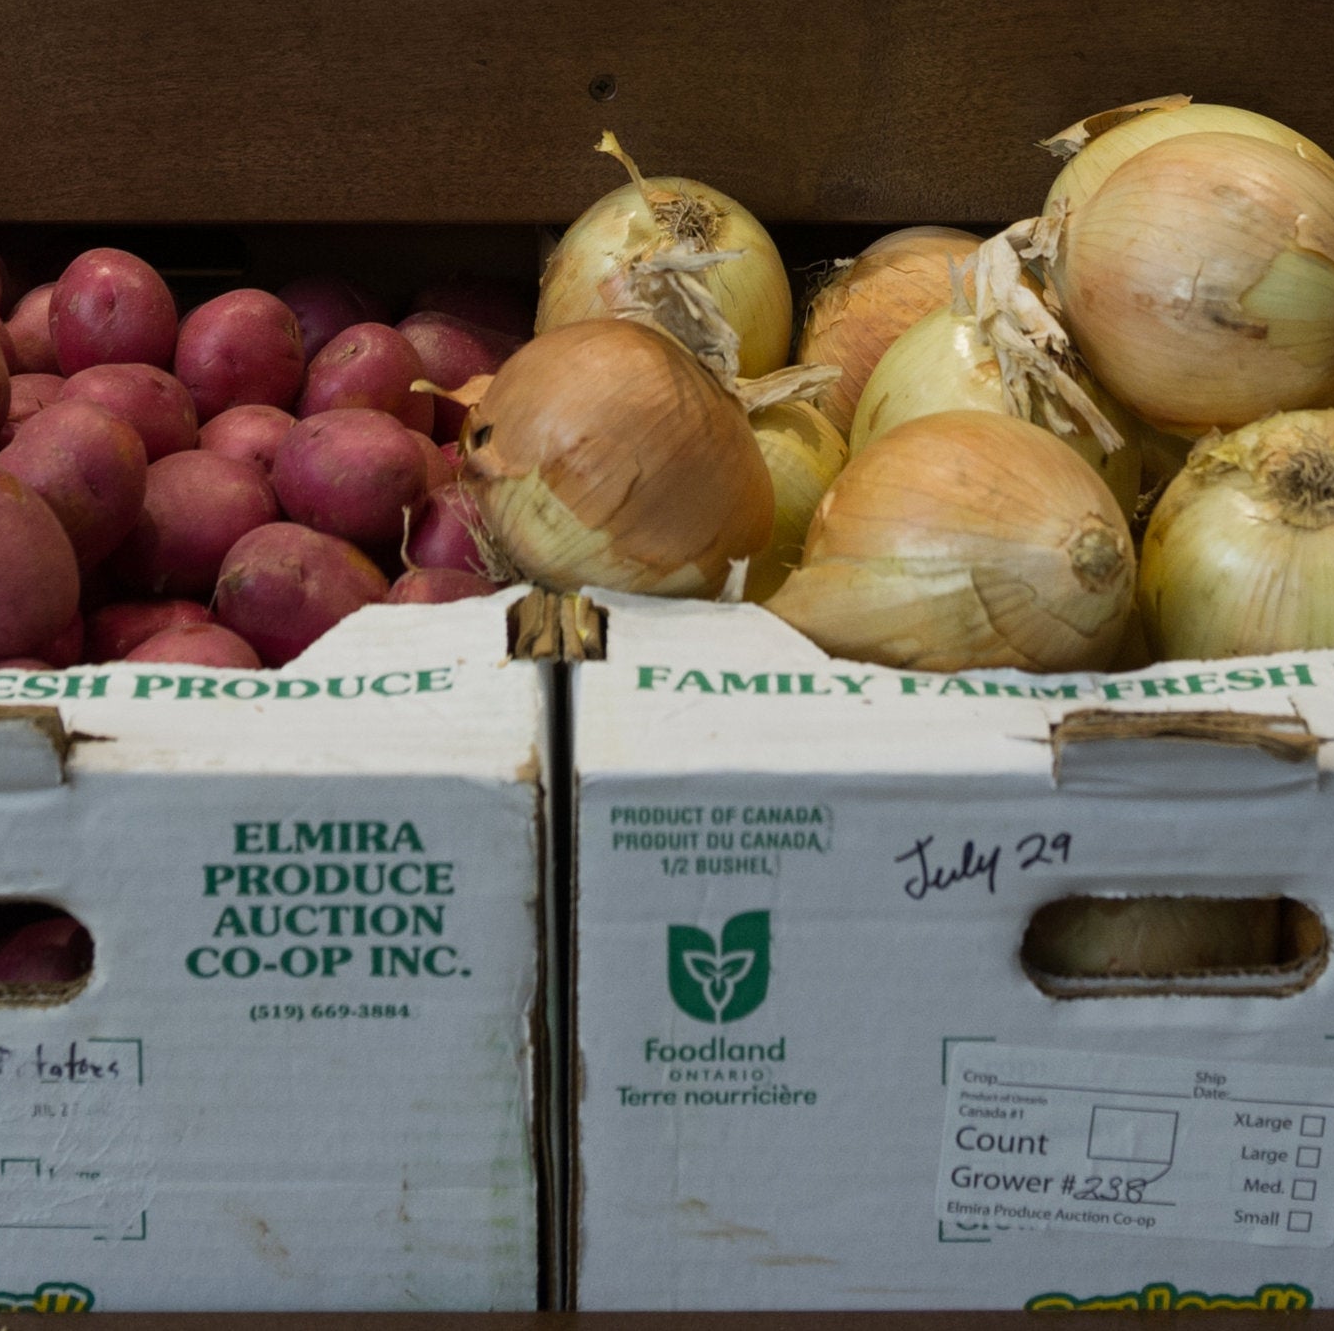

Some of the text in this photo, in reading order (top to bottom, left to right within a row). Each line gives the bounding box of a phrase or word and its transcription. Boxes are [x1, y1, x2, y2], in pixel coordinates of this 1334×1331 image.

[133, 668, 452, 699] PRODUCE
[638, 666, 872, 695] FAMILY
[901, 677, 1078, 699] FARM
[1098, 665, 1315, 700] FRESH
[611, 806, 823, 825] PRODUCT CANADA
[234, 821, 424, 854] ELMIRA
[613, 831, 824, 853] PRODUIT CANADA
[661, 856, 773, 877] 1/2 BUSHEL
[895, 832, 1072, 900] July 29
[203, 863, 454, 896] PRODUCE
[213, 904, 445, 937] AUCTION
[185, 946, 471, 978] CO-OP INC.
[249, 1005, 305, 1022] (519)
[645, 1036, 785, 1063] Foodland
[963, 1071, 999, 1086] Crop
[616, 1084, 817, 1106] Terre nourricière
[1009, 1109, 1024, 1119] #1
[1234, 1113, 1293, 1133] XLarge
[956, 1125, 1049, 1155] Count
[1241, 1146, 1288, 1165] Large
[951, 1165, 1054, 1193] Grower
[994, 1203, 1156, 1229] Produce Co-op
[1234, 1209, 1280, 1226] Small
